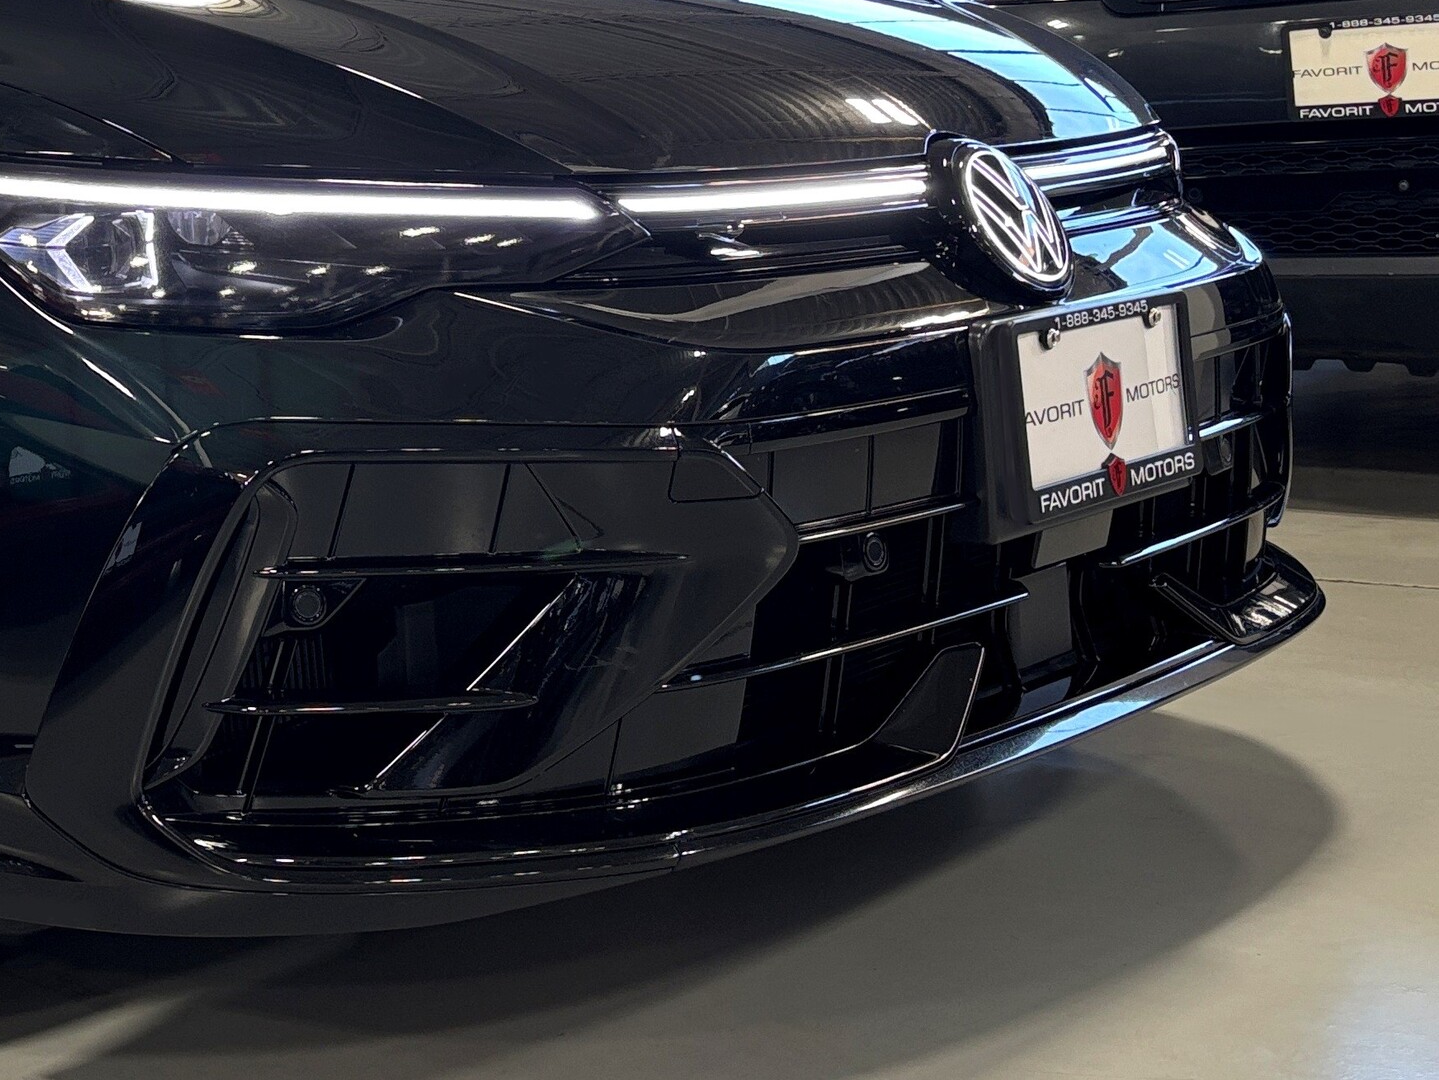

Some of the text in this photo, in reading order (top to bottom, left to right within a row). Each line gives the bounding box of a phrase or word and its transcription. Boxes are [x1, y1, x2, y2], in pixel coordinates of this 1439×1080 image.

[1293, 65, 1363, 79] FAVORIT
[1300, 105, 1374, 119] FAVORIT
[1055, 299, 1149, 329] 1-888-345-9345
[1126, 373, 1181, 403] MOTORS
[1040, 451, 1195, 514] FAVORIT MOTORS
